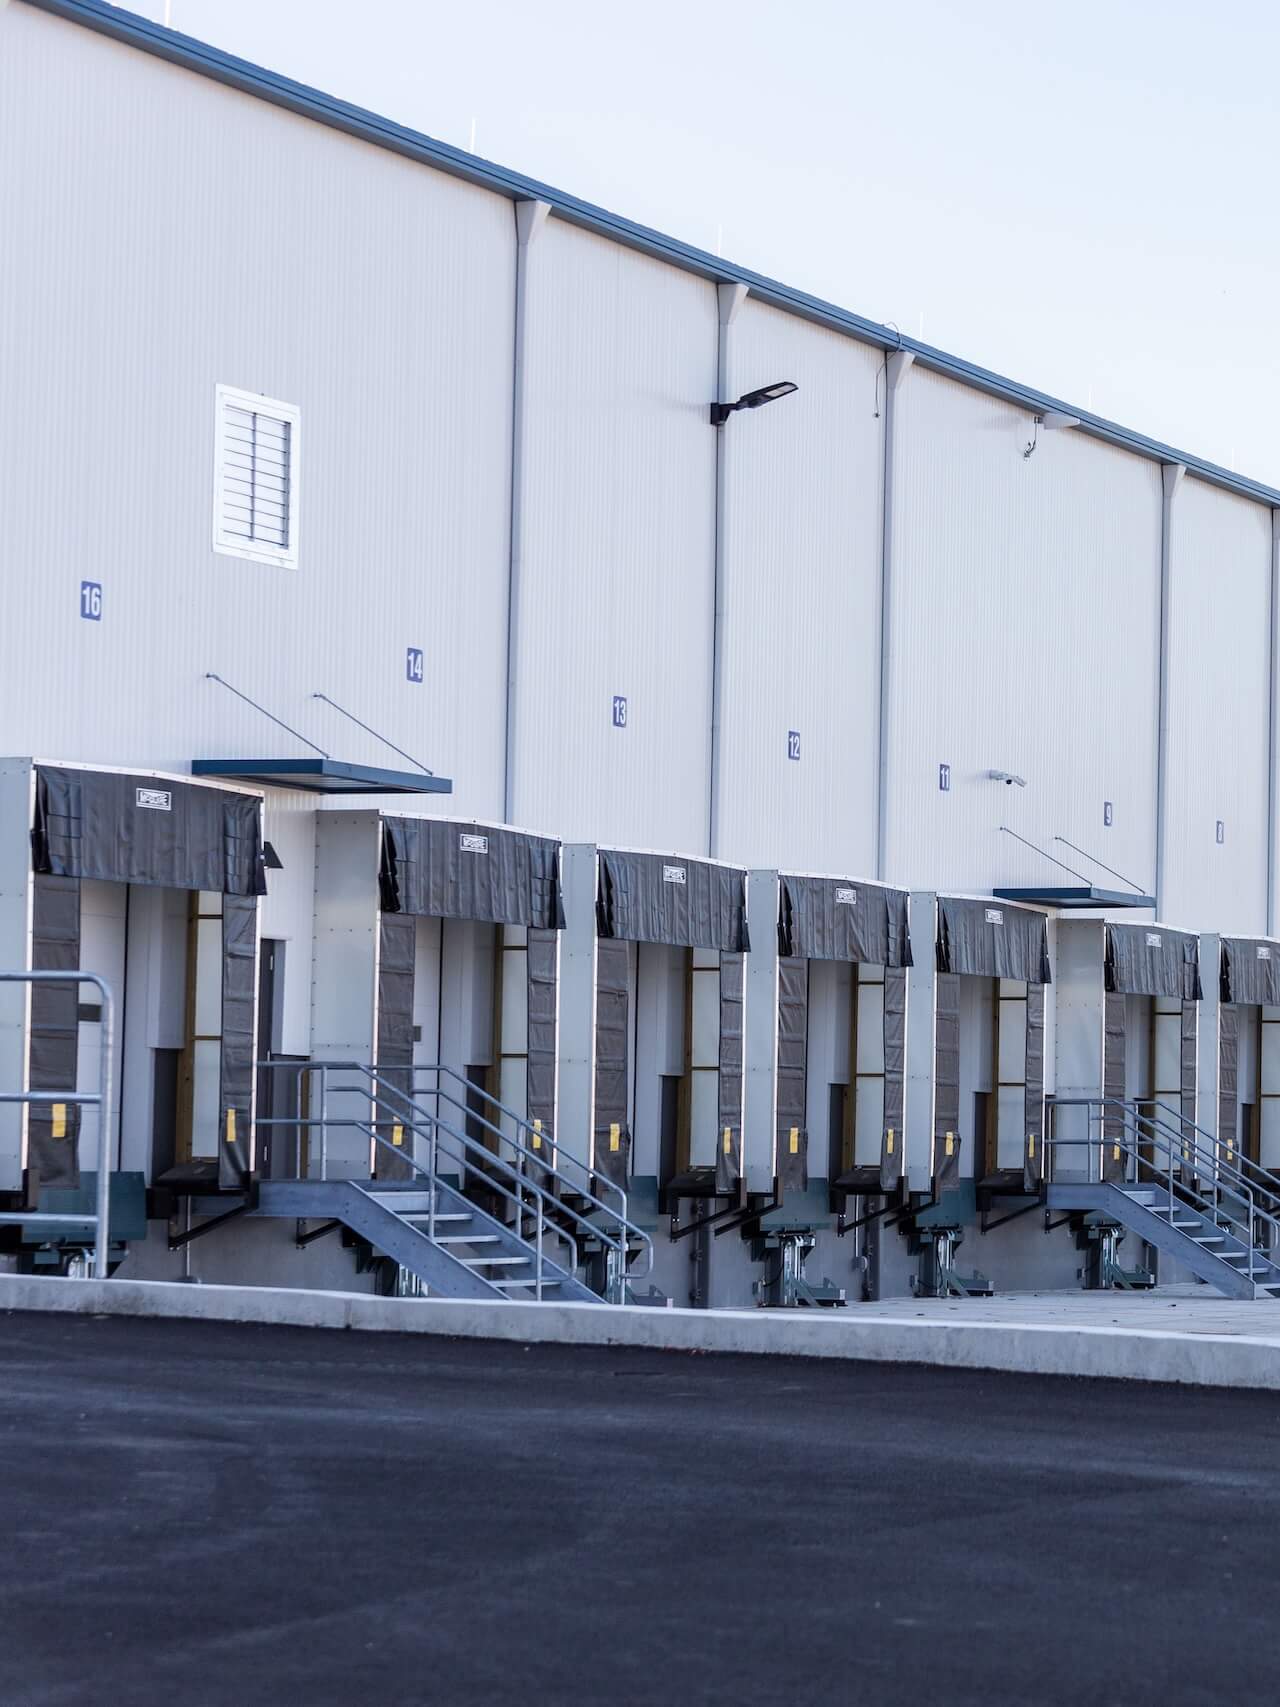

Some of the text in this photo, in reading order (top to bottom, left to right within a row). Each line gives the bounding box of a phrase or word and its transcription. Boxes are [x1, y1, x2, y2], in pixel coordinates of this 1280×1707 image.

[82, 586, 101, 617] 16
[408, 652, 423, 679] 14
[614, 699, 626, 725] 13
[789, 735, 800, 758] 12
[941, 767, 950, 790] 11
[1106, 804, 1112, 824] 9
